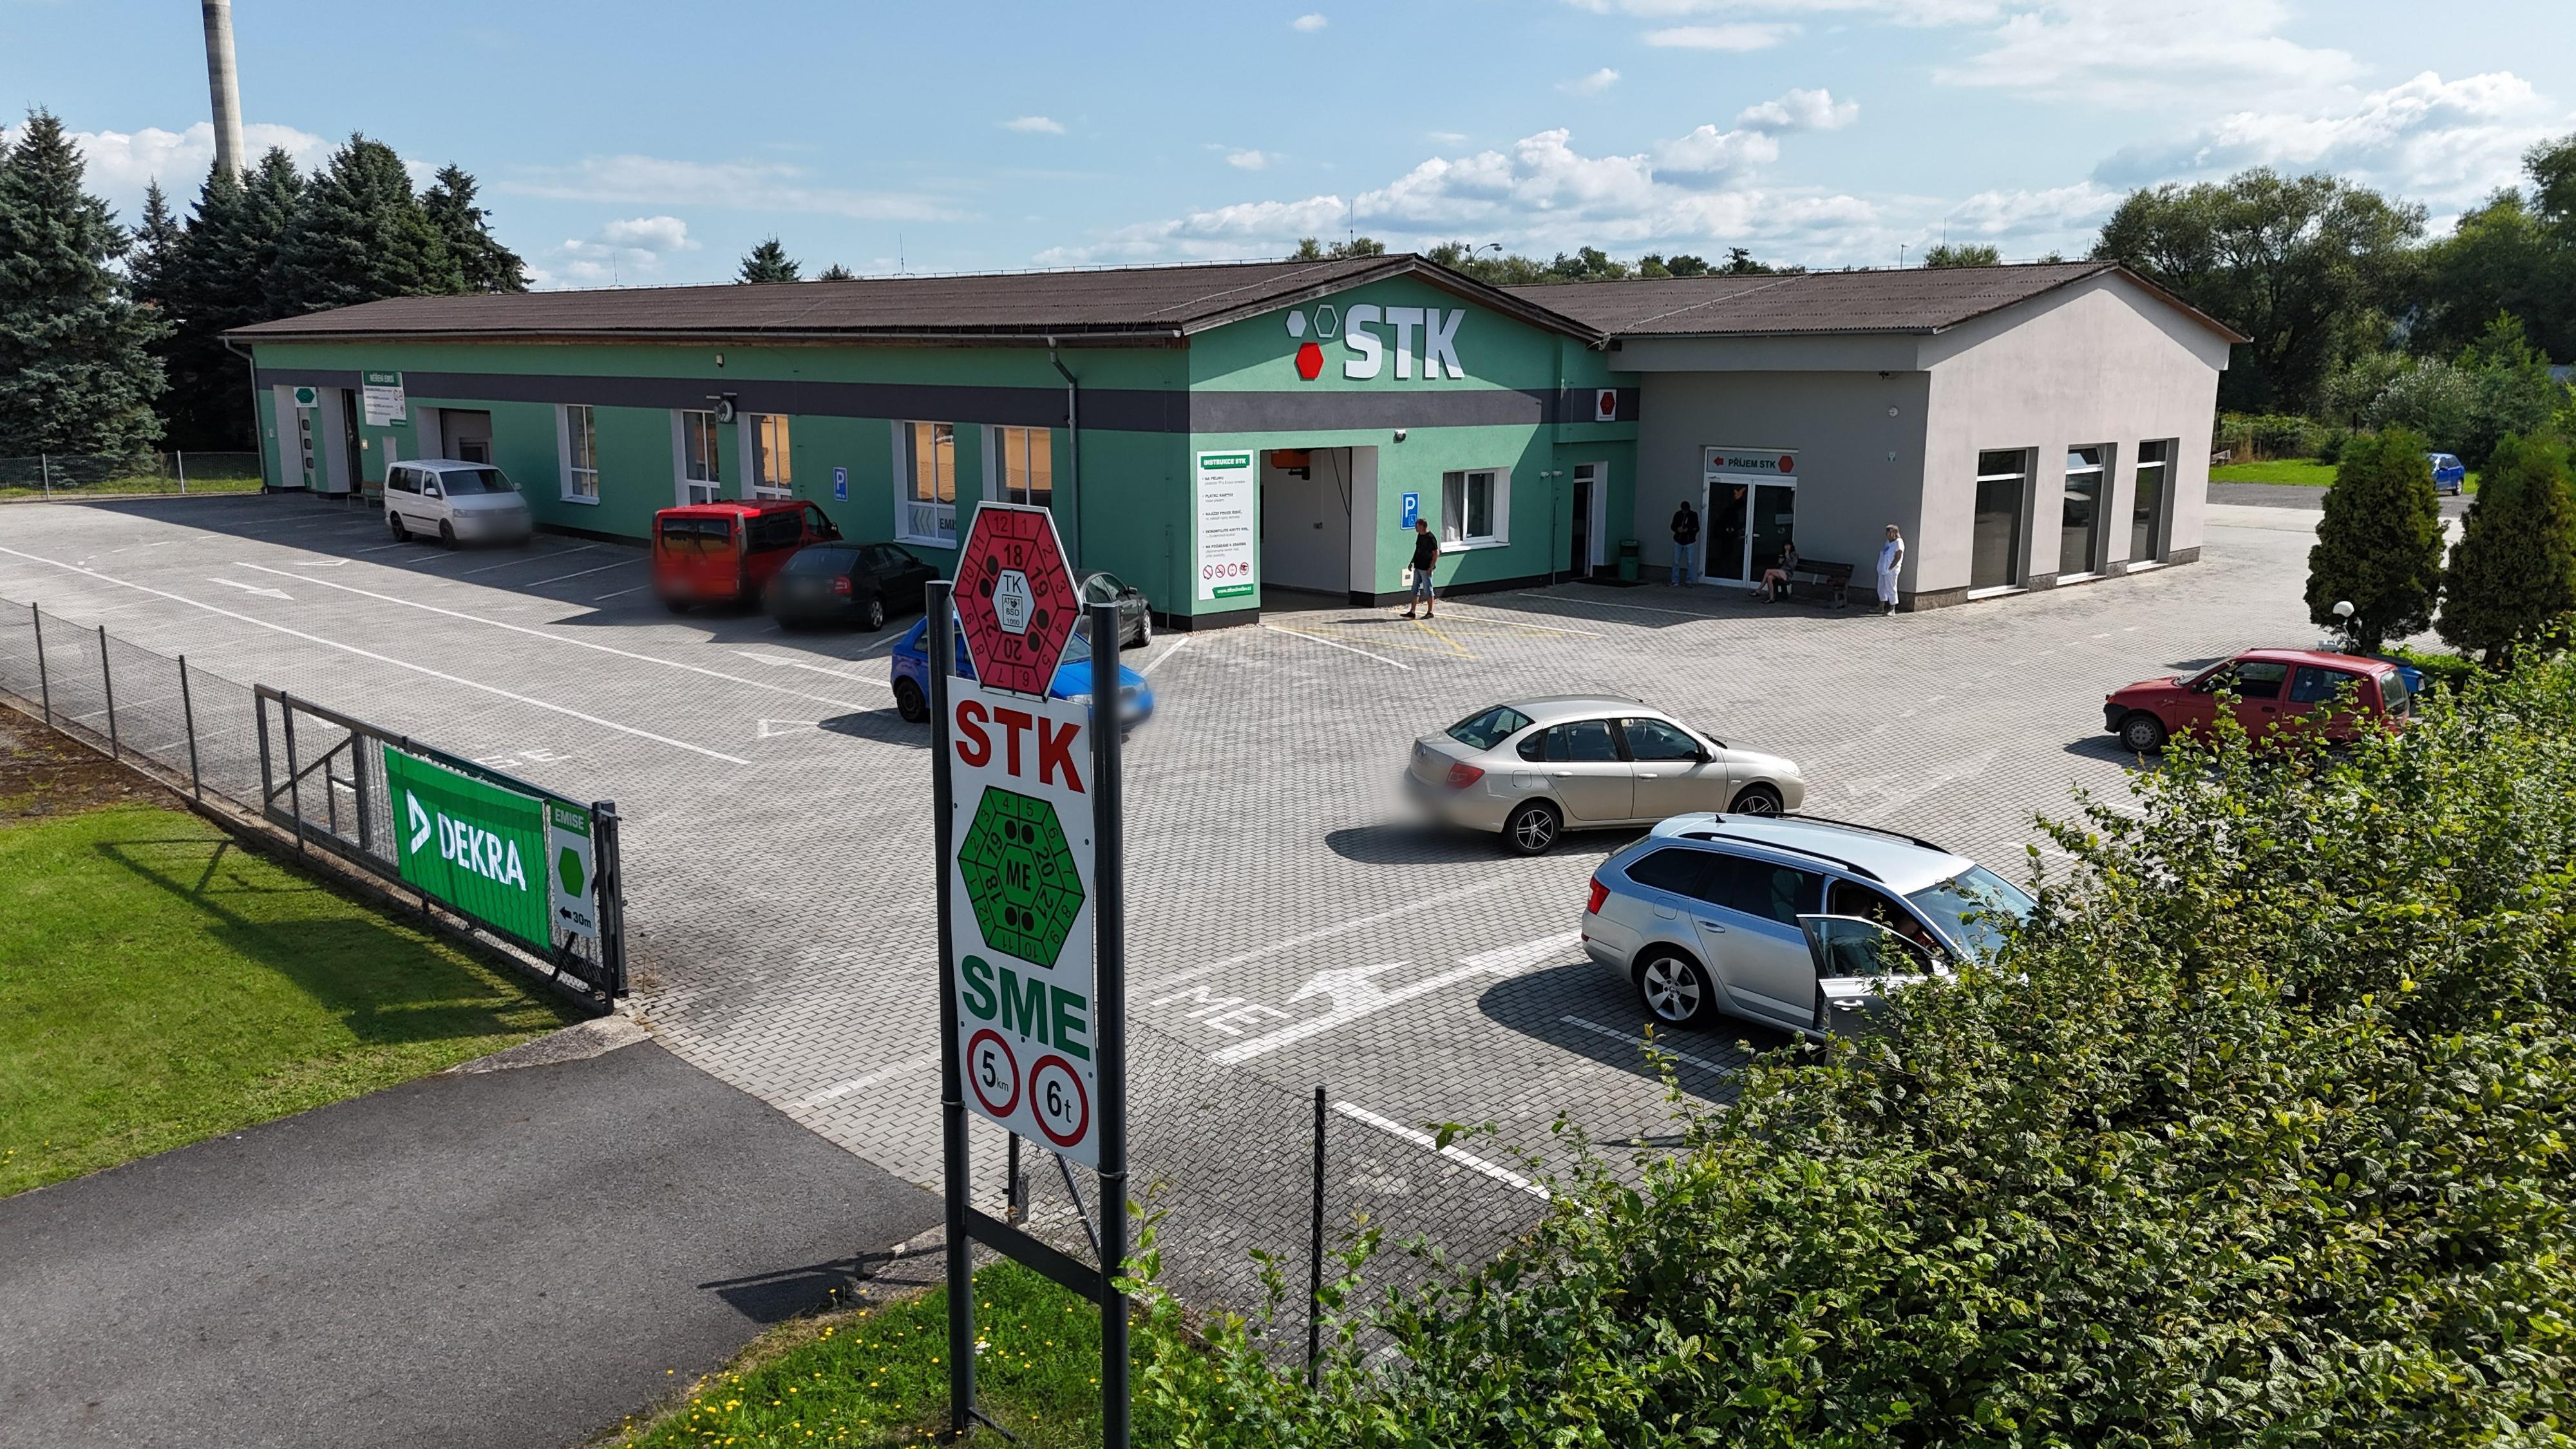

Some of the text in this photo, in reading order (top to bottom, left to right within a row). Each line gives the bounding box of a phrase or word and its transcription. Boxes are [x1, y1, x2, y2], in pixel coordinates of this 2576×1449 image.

[1344, 304, 1466, 379] STK
[1728, 457, 1776, 469] PŘÍJEM STK
[836, 471, 844, 490] P
[1405, 497, 1416, 518] P
[940, 518, 956, 530] EMI
[994, 516, 1008, 533] 12
[1022, 518, 1027, 535] 1
[973, 534, 985, 553] 11
[1042, 545, 1054, 559] 2
[1005, 544, 1023, 567] 18
[962, 565, 974, 585] 10
[1003, 574, 1022, 594] TK
[1030, 566, 1048, 598] 19
[1056, 582, 1066, 594] 3
[981, 609, 999, 638] 21
[1055, 622, 1063, 637] 4
[976, 643, 985, 656] 8
[1005, 638, 1022, 661] 20
[1042, 654, 1052, 668] 5
[998, 671, 1004, 683] 7
[956, 699, 1086, 794] STK
[1003, 797, 1009, 810] 4
[1027, 803, 1034, 817] 5
[554, 808, 584, 831] EMISE
[981, 810, 990, 822] 3
[437, 811, 527, 892] DEKRA
[970, 838, 980, 851] 2
[985, 832, 1003, 860] 19
[1034, 847, 1055, 876] 20
[1063, 865, 1074, 875] 7
[1007, 858, 1032, 891] ME
[985, 875, 1003, 904] 18
[1036, 890, 1054, 920] 21
[1061, 904, 1072, 917] 8
[573, 911, 592, 929] 30m
[978, 905, 989, 925] 12
[1002, 936, 1014, 949] 11
[1025, 943, 1037, 959] 10
[961, 954, 1091, 1062] SME
[1149, 985, 1293, 1036] ME
